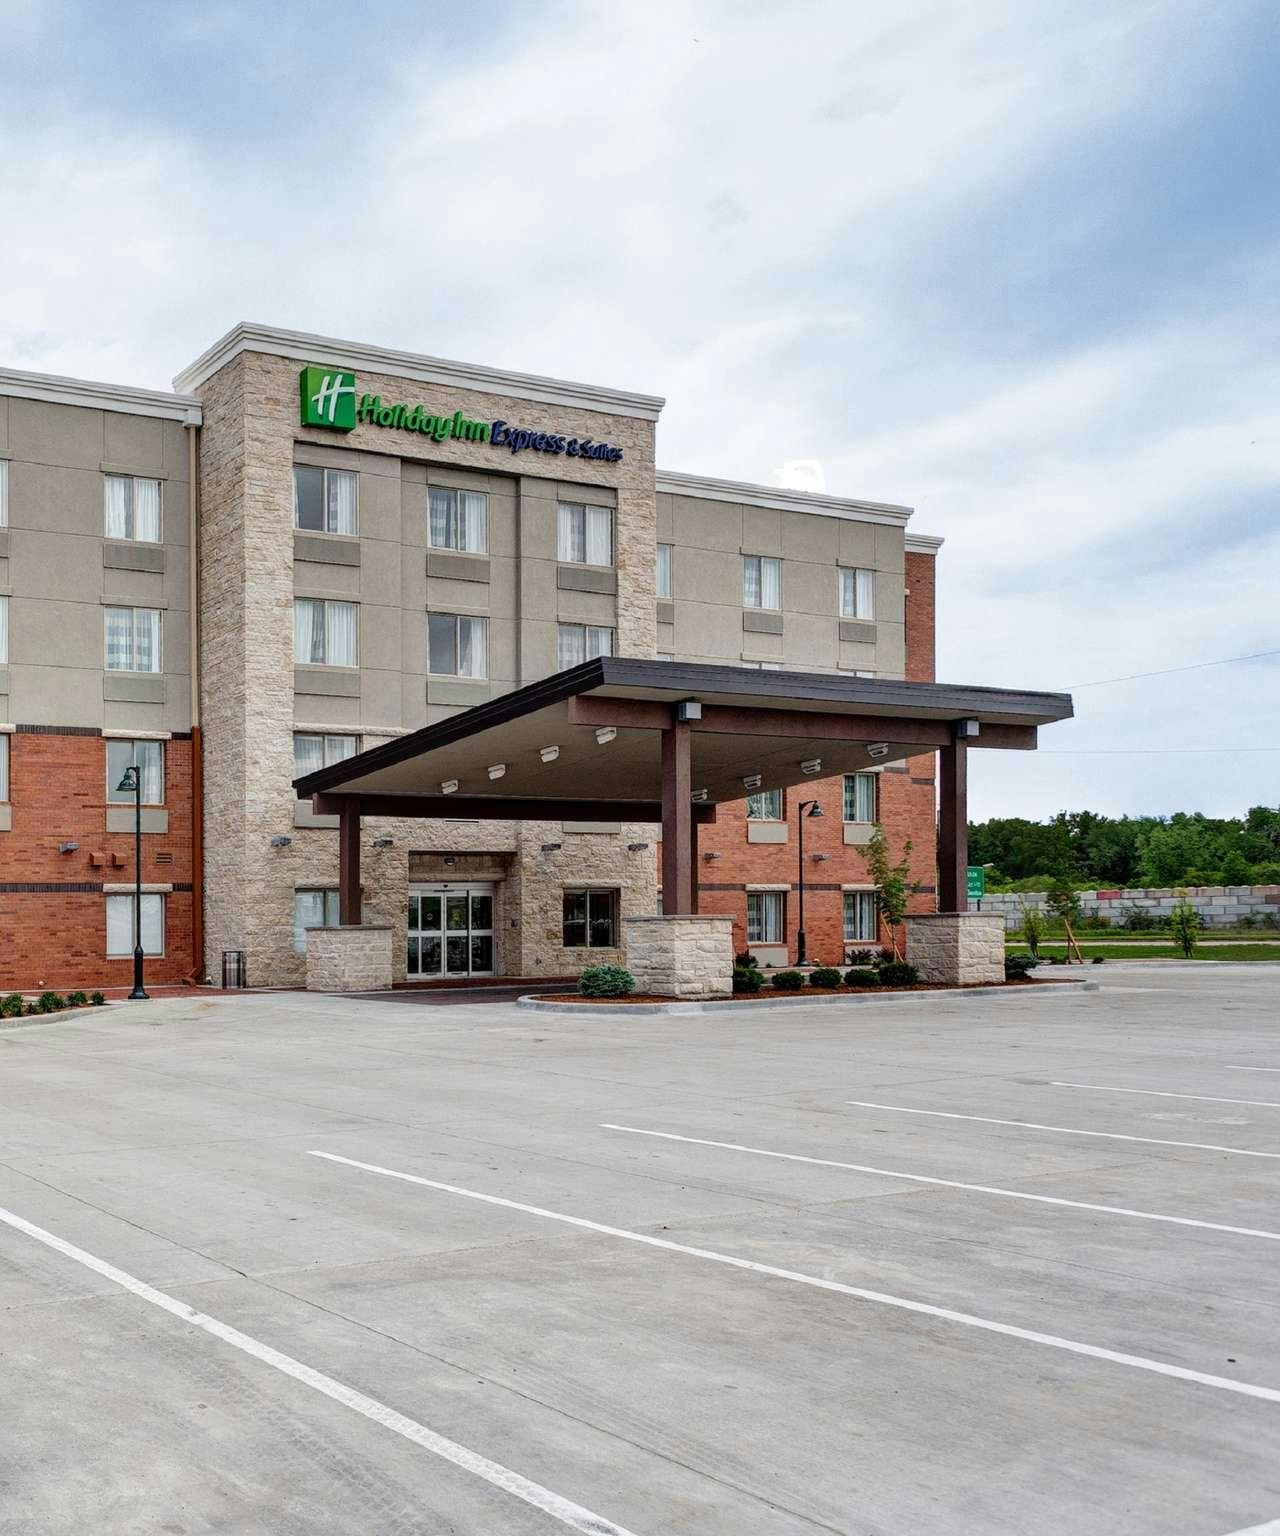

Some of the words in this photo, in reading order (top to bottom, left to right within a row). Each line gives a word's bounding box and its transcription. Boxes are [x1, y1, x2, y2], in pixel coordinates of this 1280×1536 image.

[358, 394, 451, 443] Holiday
[451, 410, 489, 442] Inn
[490, 420, 566, 454] Express
[566, 438, 579, 457] &
[579, 440, 623, 461] Suites
